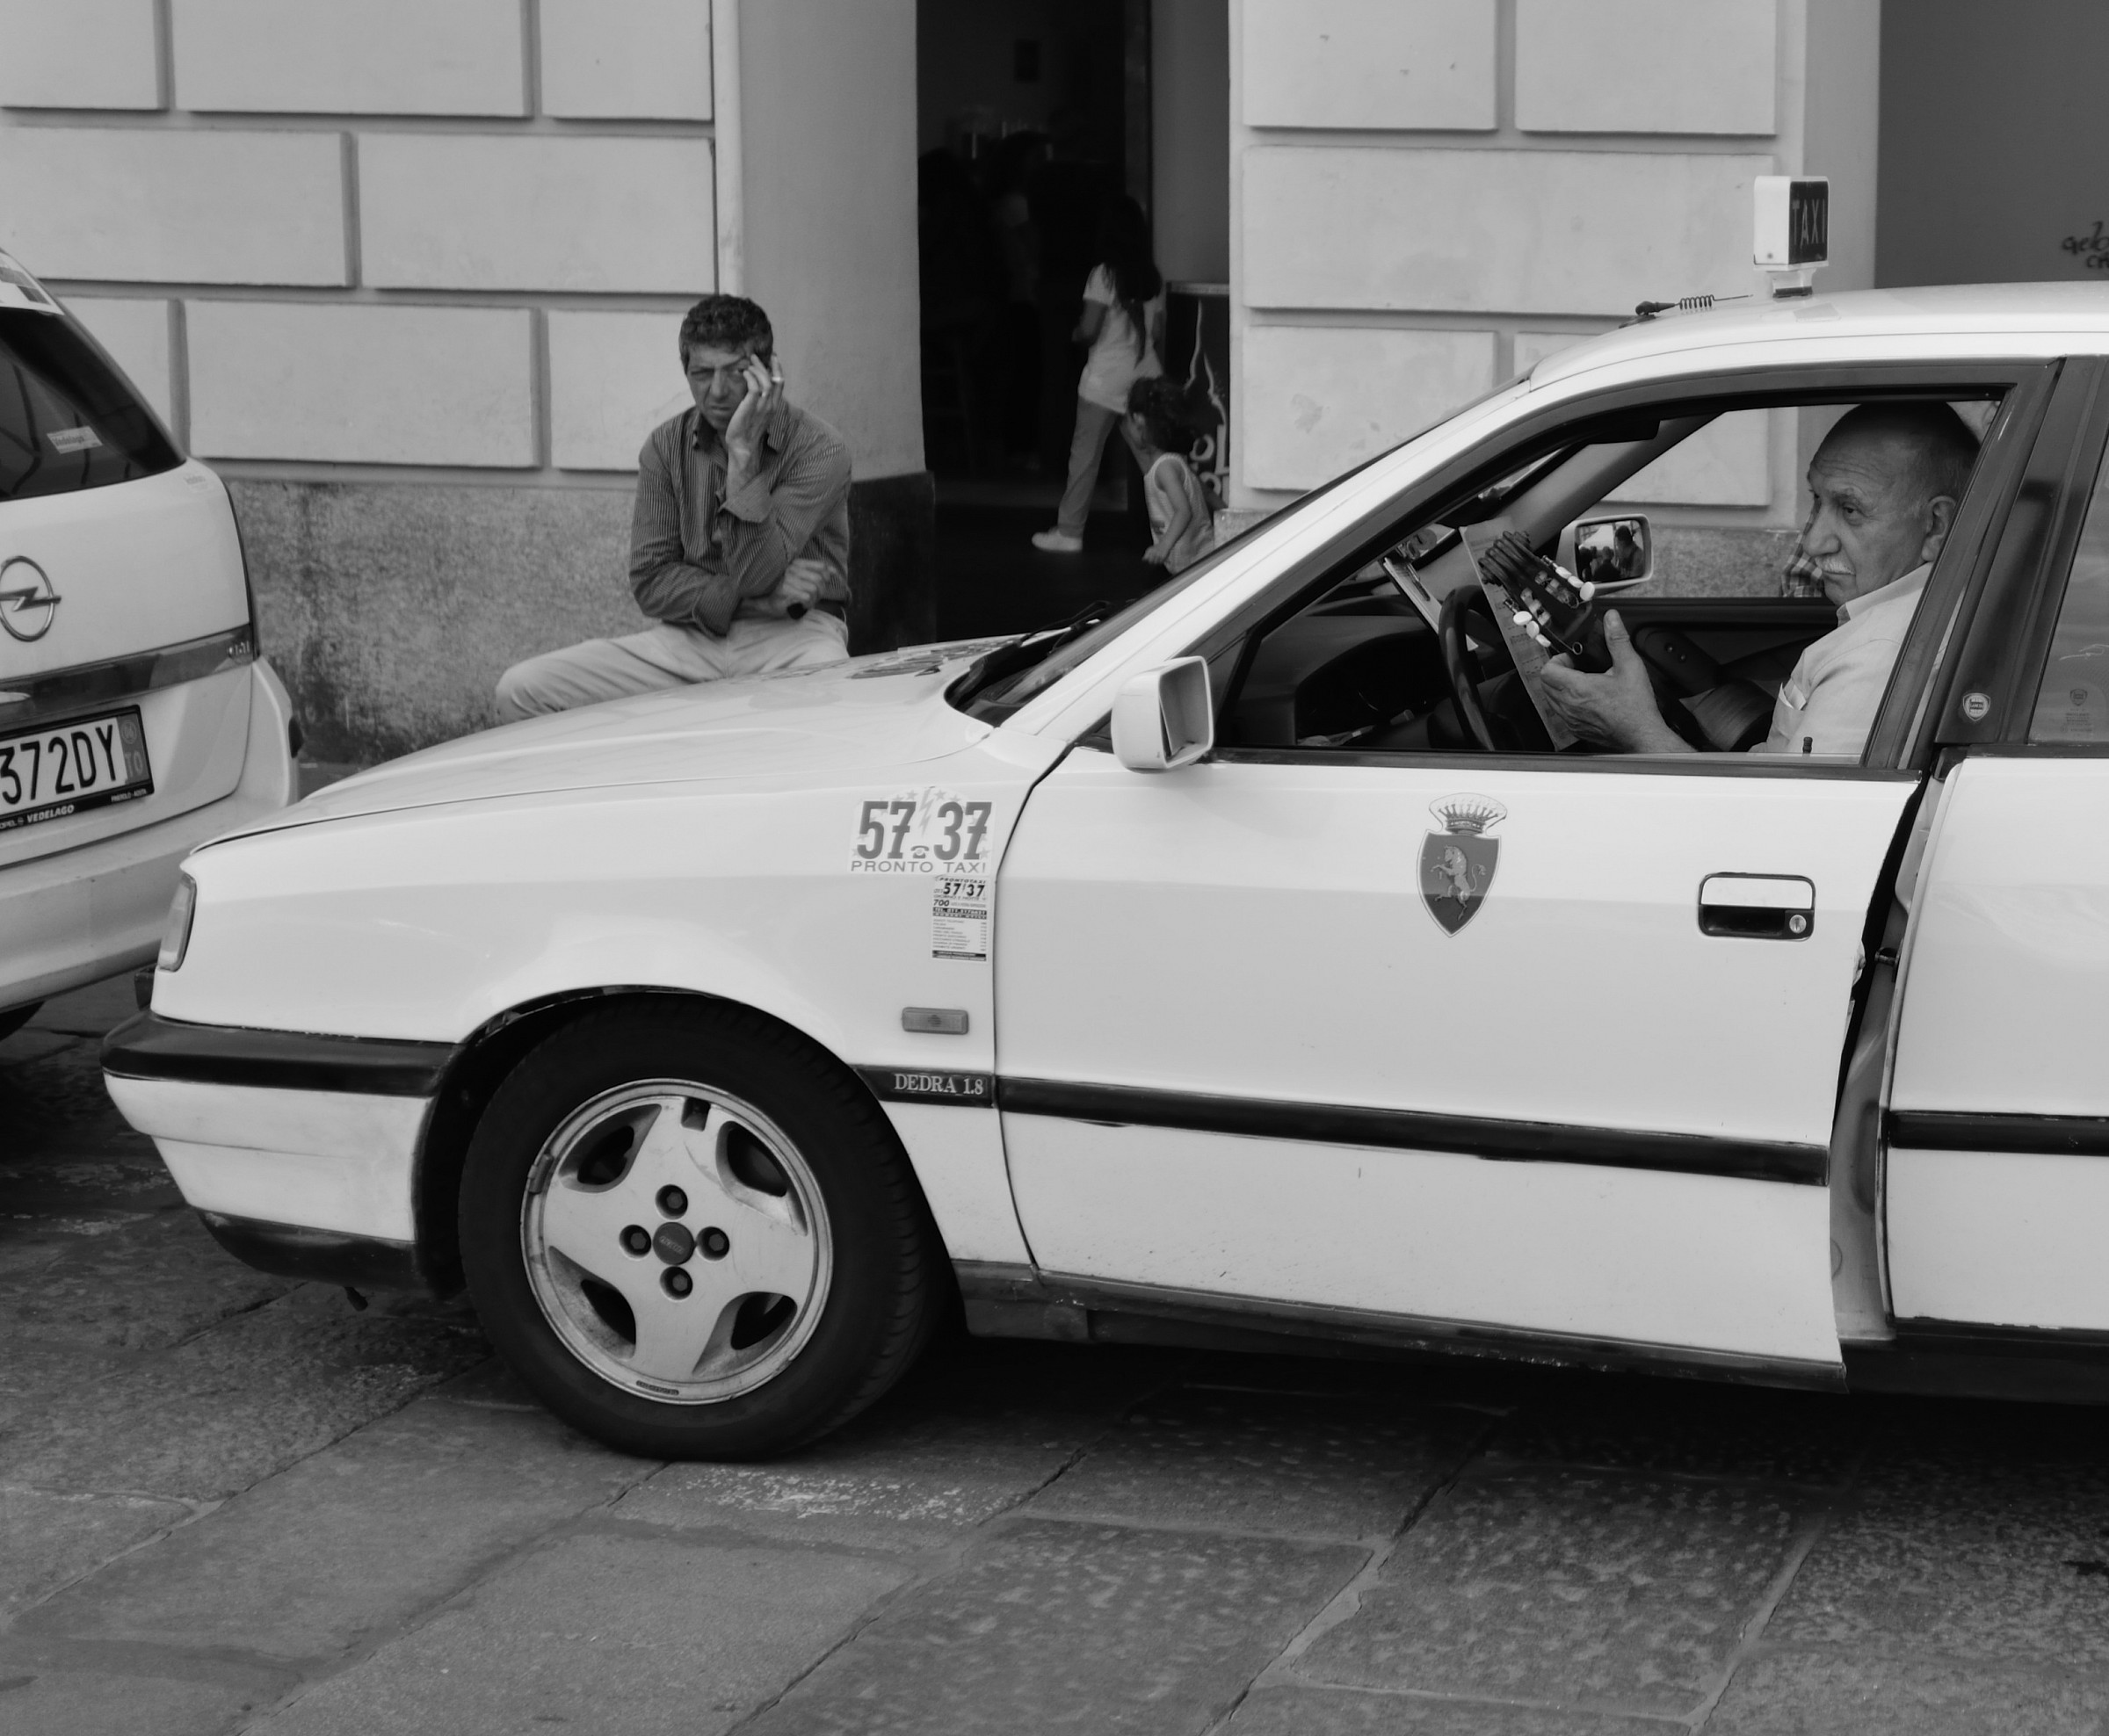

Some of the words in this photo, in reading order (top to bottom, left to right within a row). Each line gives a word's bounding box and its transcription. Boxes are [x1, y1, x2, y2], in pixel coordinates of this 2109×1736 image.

[1793, 199, 1825, 247] TAXI
[0, 725, 116, 805] 372DY
[27, 804, 75, 823] VEDELAGO
[851, 860, 933, 872] PRONTO
[943, 862, 986, 873] TAXI
[894, 1074, 957, 1093] DEDRA
[963, 1078, 983, 1095] 1.8
